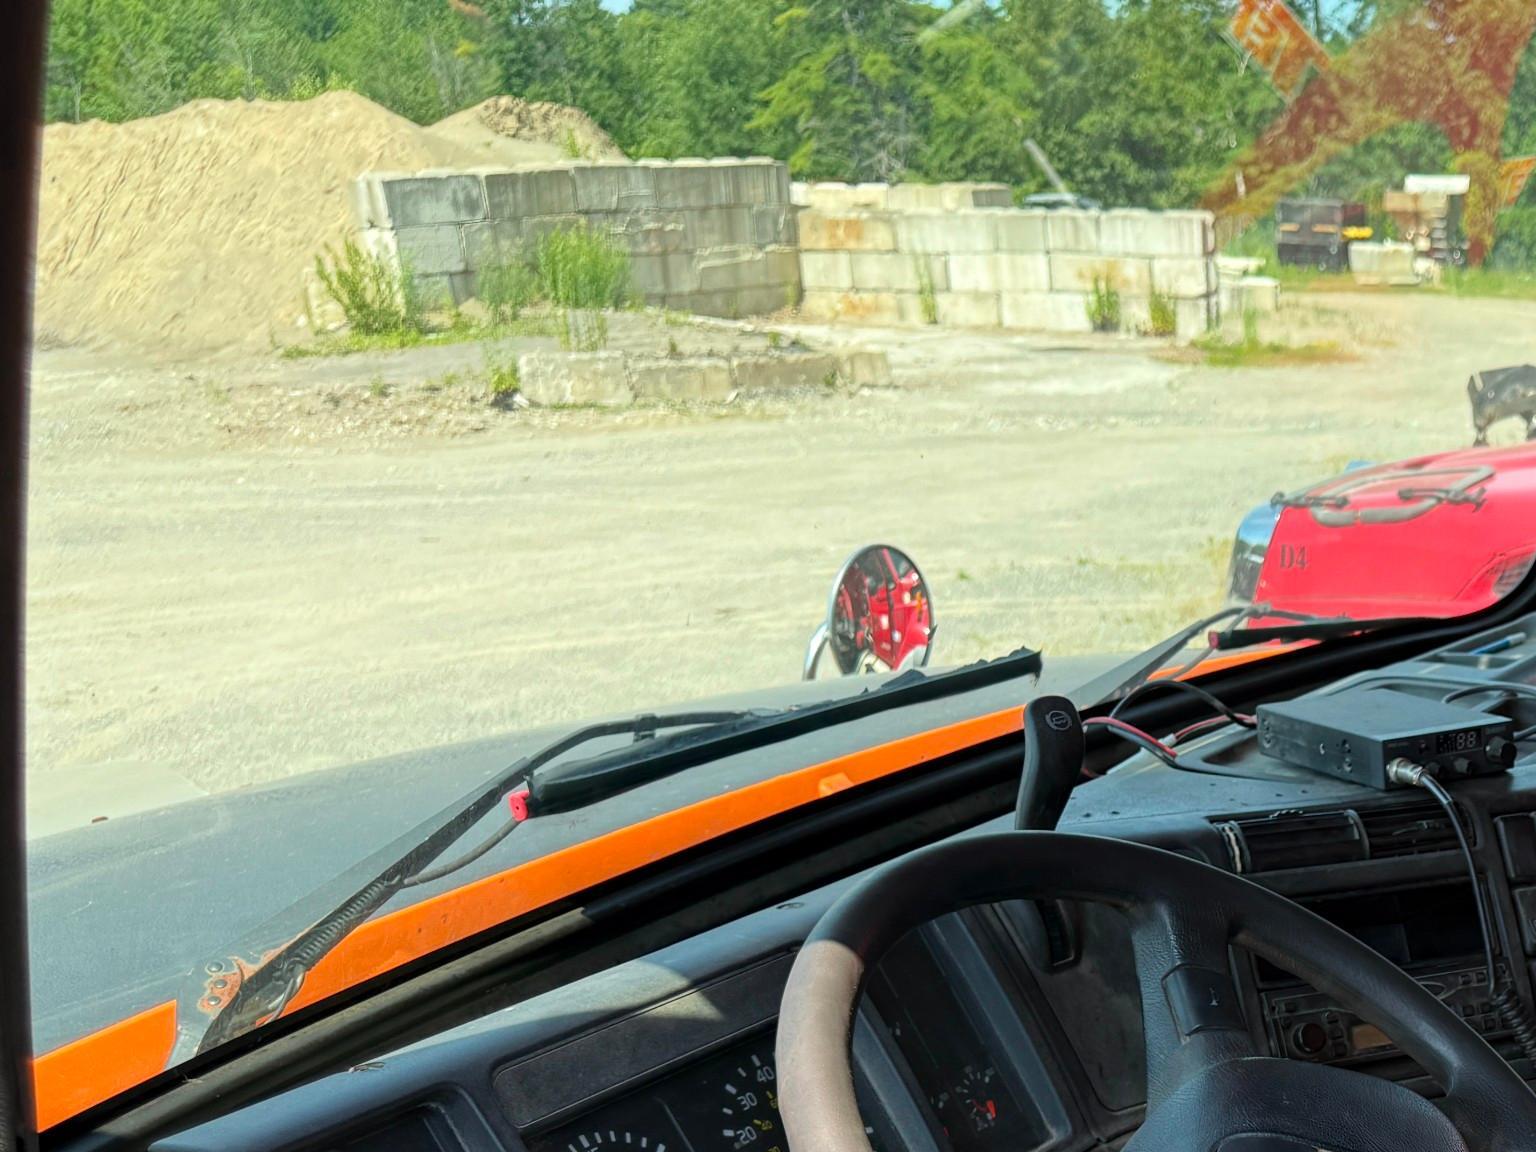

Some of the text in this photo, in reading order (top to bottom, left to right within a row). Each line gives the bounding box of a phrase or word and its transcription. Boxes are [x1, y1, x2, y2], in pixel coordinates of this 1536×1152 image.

[756, 1065, 775, 1083] 40
[736, 1092, 758, 1111] 30
[736, 1126, 758, 1145] 20
